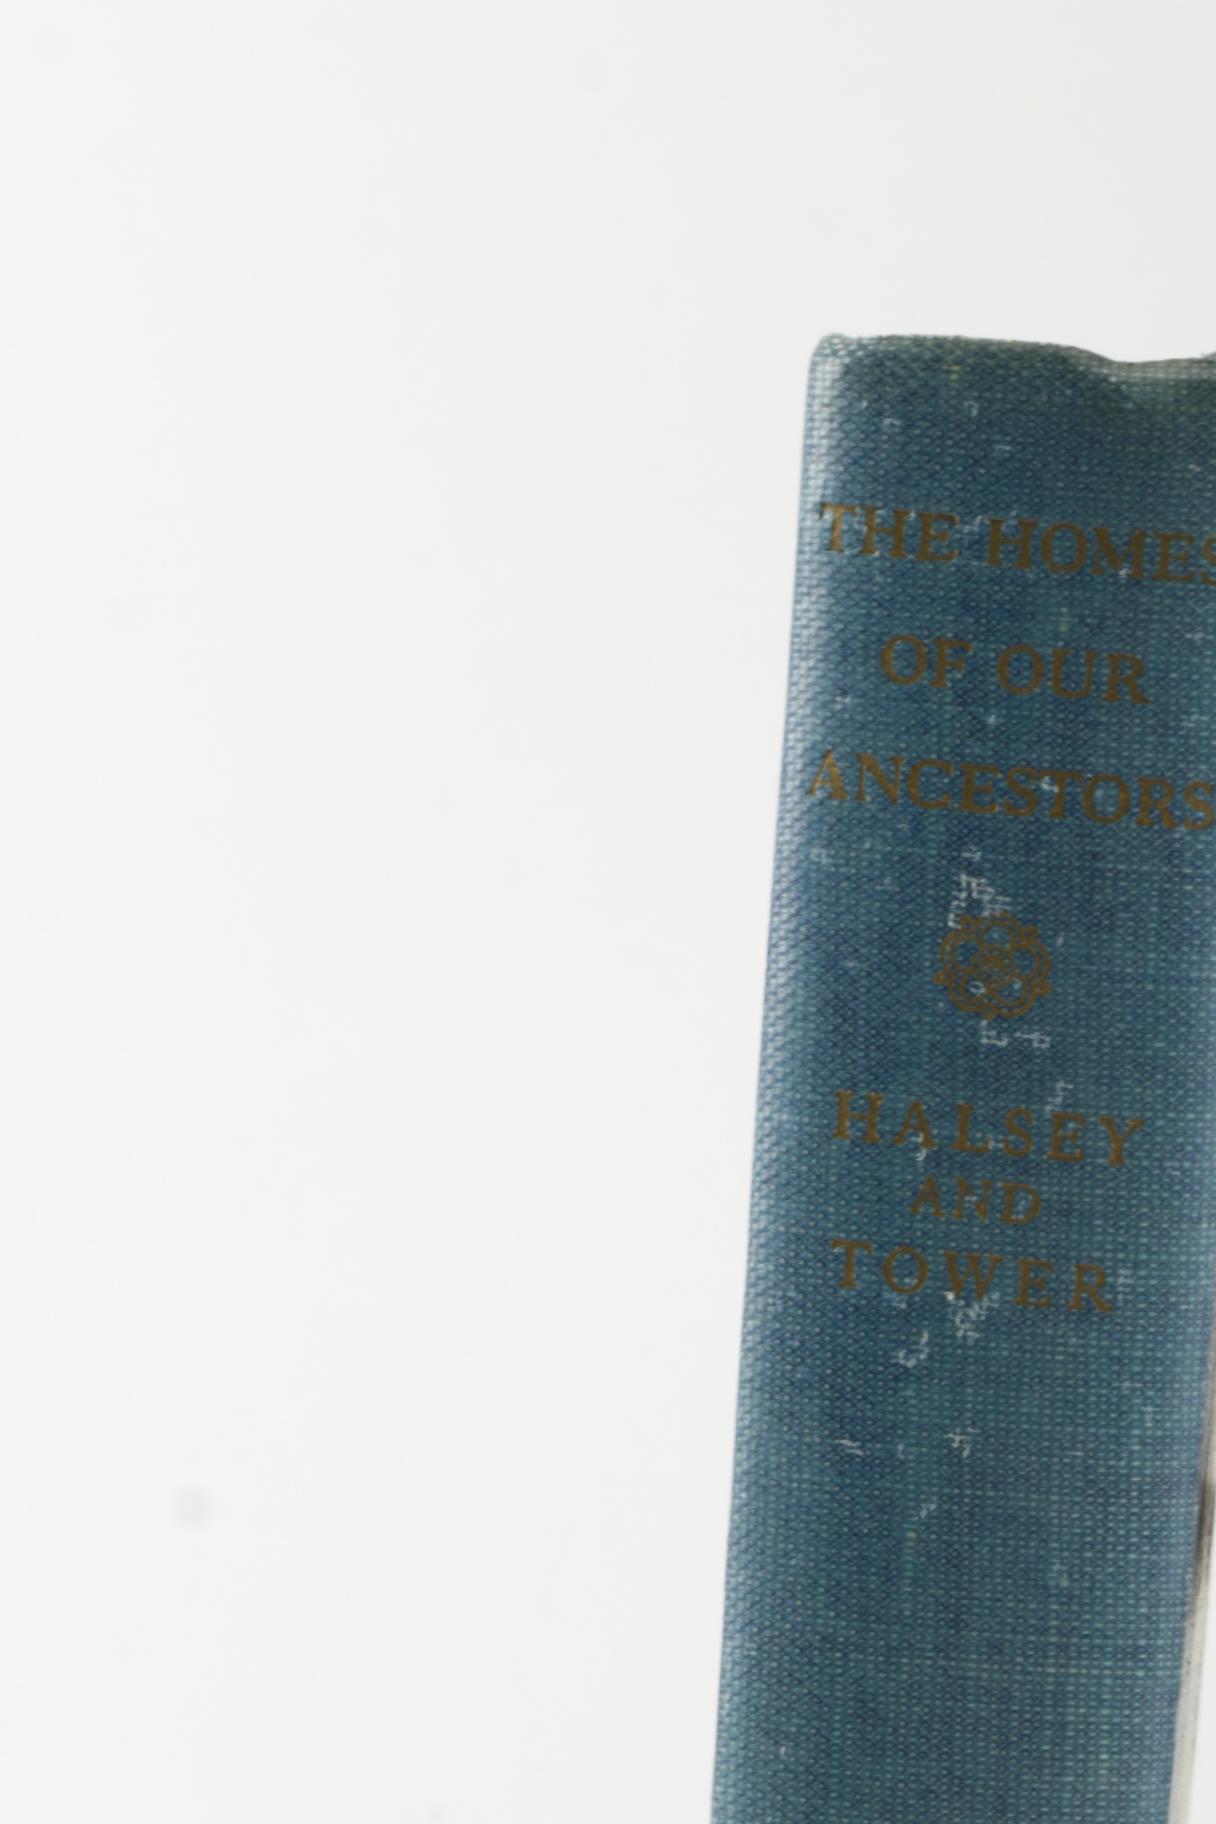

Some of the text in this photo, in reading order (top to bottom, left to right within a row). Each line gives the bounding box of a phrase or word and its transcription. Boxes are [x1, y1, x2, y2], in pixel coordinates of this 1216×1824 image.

[818, 502, 959, 564] THE
[881, 633, 1150, 704] OF OUR
[806, 749, 1216, 832] ANCESTORS
[831, 1089, 1147, 1166] HALSEY
[911, 1176, 1042, 1226] AND
[831, 1239, 1114, 1312] TOWER
